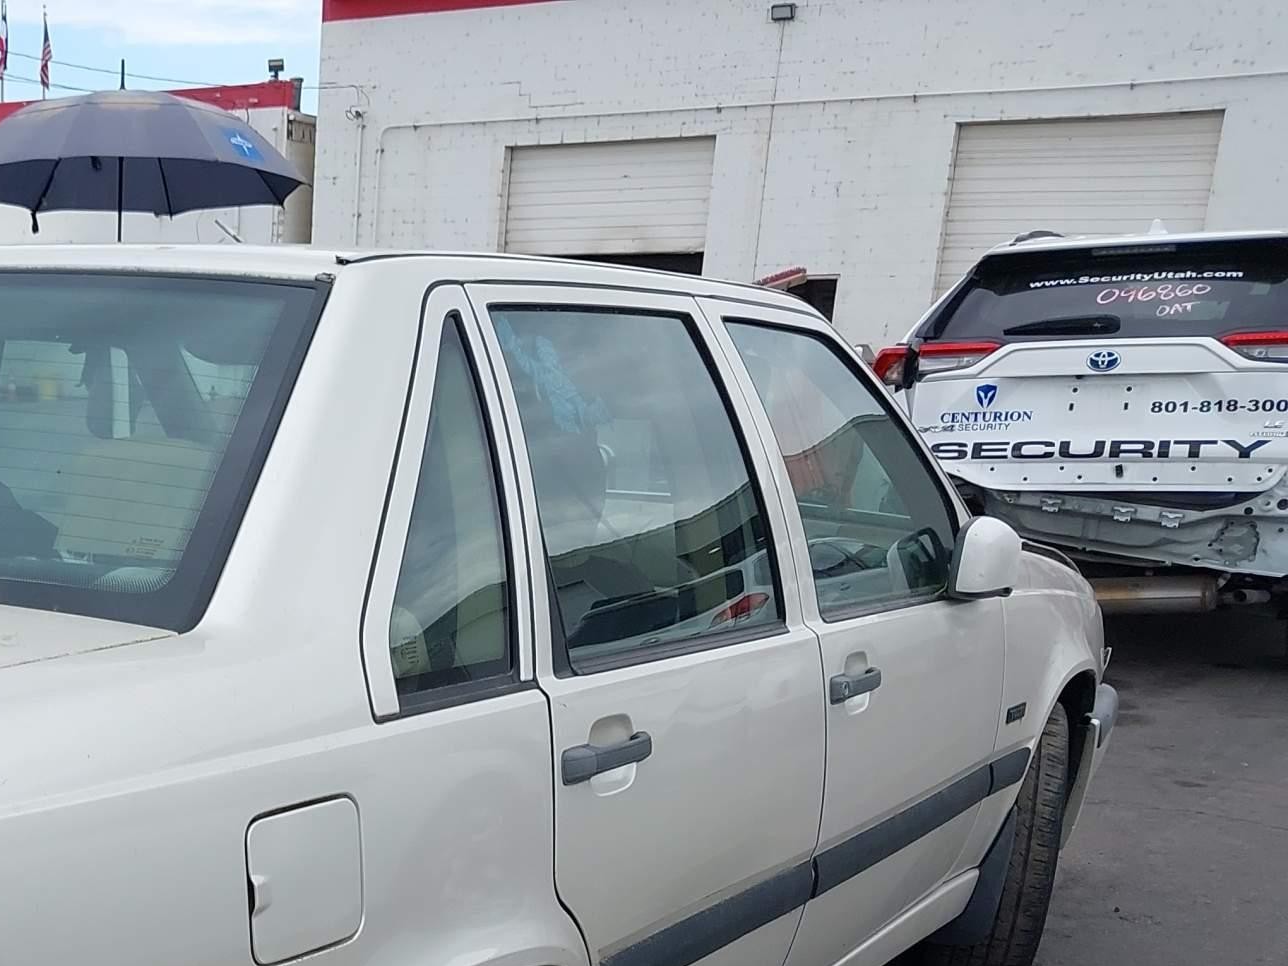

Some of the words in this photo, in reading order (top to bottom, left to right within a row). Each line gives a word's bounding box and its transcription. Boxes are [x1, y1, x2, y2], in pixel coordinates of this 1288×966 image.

[1029, 271, 1244, 289] www.SecurityUtah.com
[940, 411, 1033, 424] CENTURION
[957, 423, 1010, 432] SECURITY
[930, 440, 1272, 460] SECURITY
